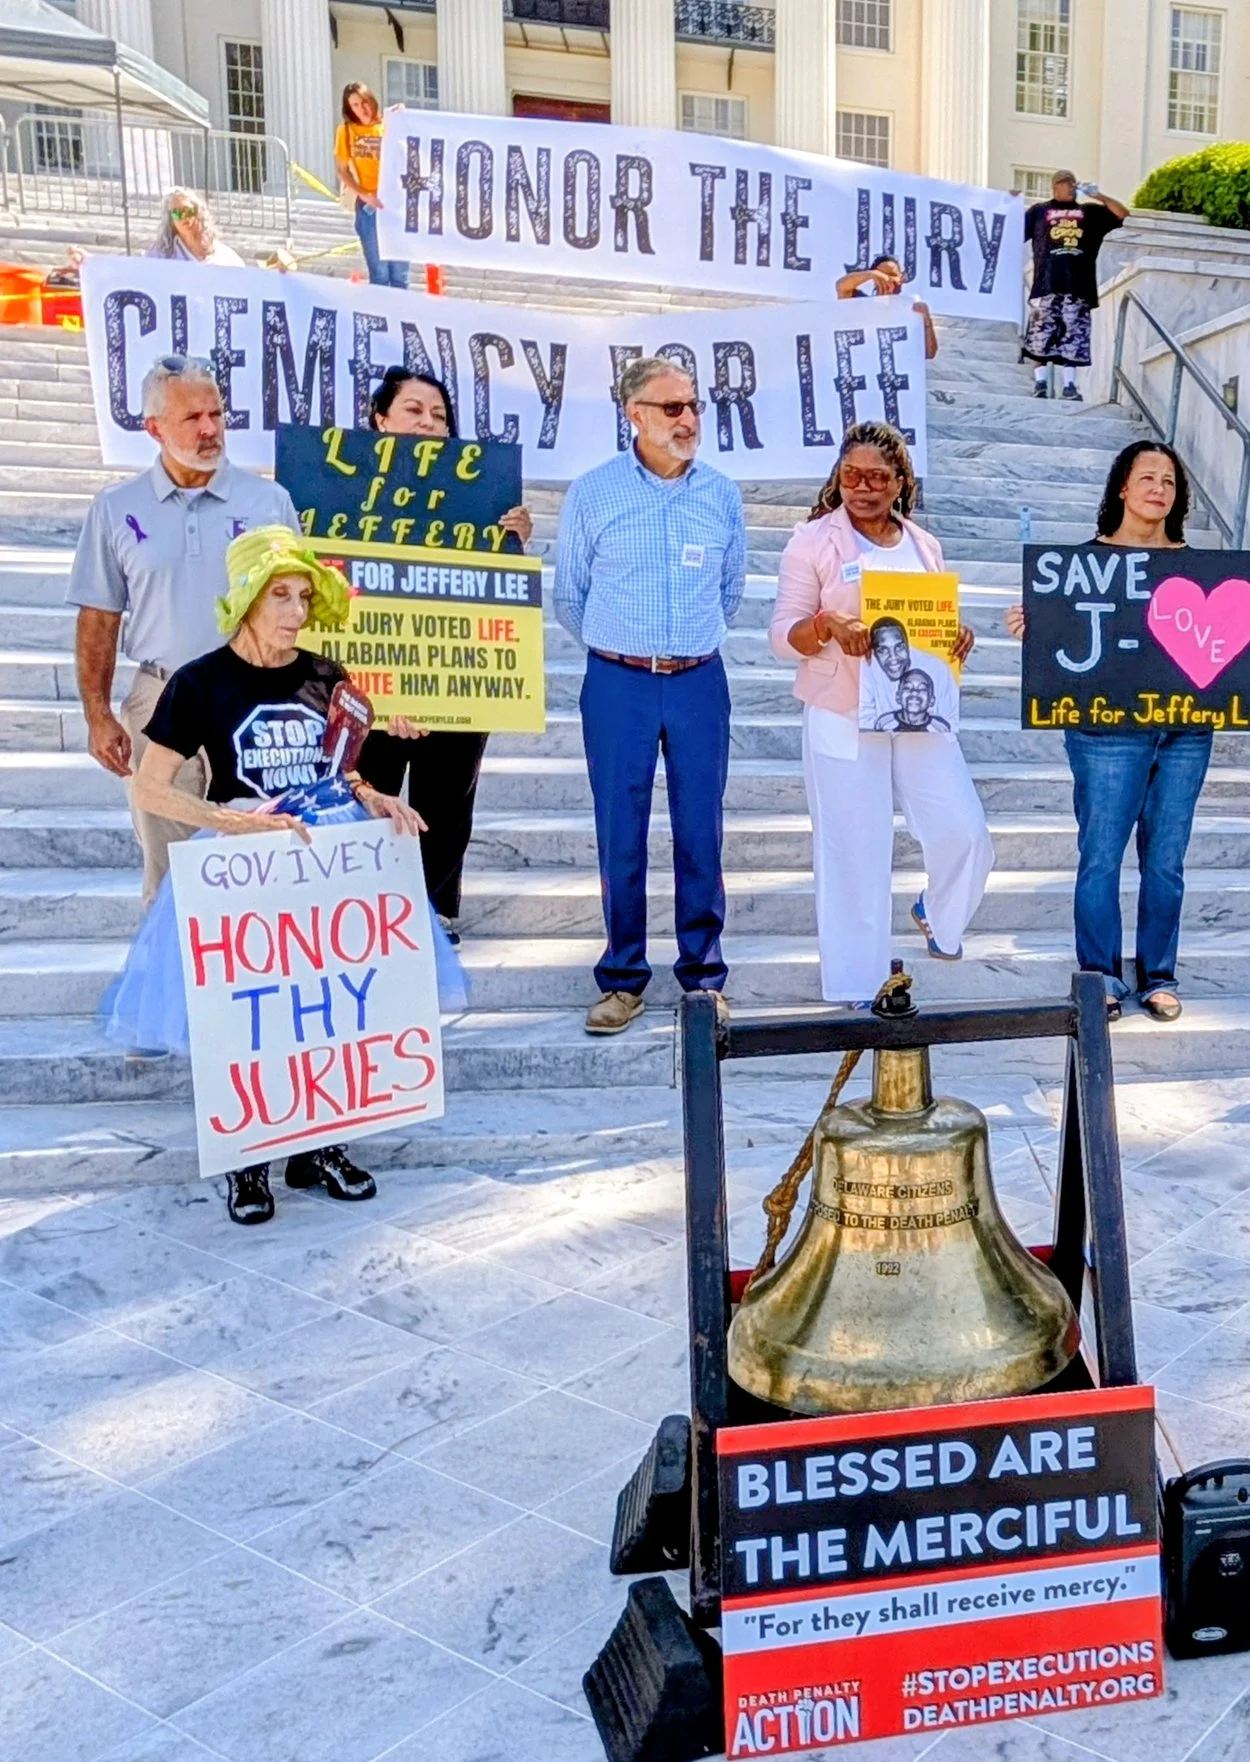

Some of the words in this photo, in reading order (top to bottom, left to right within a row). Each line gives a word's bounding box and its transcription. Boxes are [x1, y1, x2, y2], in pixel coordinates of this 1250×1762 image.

[401, 136, 655, 255] HONOR
[689, 162, 812, 272] THE
[796, 326, 916, 448] LEE
[321, 426, 482, 481] LIFE
[360, 476, 446, 512] for
[351, 561, 394, 591] FOR
[401, 564, 488, 598] JEFFERY
[494, 573, 529, 600] LEE
[1032, 552, 1152, 600] SAVE
[352, 610, 405, 637] JURY
[411, 614, 471, 640] VOTED
[478, 619, 520, 643] LIFE.
[865, 598, 881, 611] THE
[884, 599, 905, 612] JURY
[907, 599, 933, 612] VOTED
[1150, 595, 1227, 664] LOVE
[321, 640, 420, 667] ALABAMA
[428, 645, 488, 669] PLANS
[494, 648, 517, 670] TO
[400, 674, 439, 697] HIM
[447, 675, 531, 700] ANYWAY.
[1031, 697, 1081, 725] Life
[1090, 697, 1125, 724] for
[1134, 693, 1226, 729] Jeffery
[251, 719, 324, 747] STOP
[201, 851, 279, 890] GOV.
[287, 836, 400, 883] IVEY:
[188, 894, 420, 986] HONOR
[232, 967, 378, 1051] THY
[210, 1028, 437, 1134] JURIES
[832, 1179, 894, 1198] DELAWARE
[897, 1181, 953, 1199] CITIZENS
[844, 1213, 858, 1227] TO
[861, 1215, 886, 1229] THE
[890, 1215, 933, 1229] DEATH
[876, 1261, 900, 1276] 1992
[737, 1441, 976, 1509] BLESSED
[988, 1426, 1096, 1478] ARE
[735, 1527, 849, 1583] THE
[863, 1493, 1141, 1568] MERCIFUL
[744, 1612, 803, 1639] "For
[811, 1605, 871, 1636] they
[879, 1592, 938, 1622] shall
[947, 1583, 1036, 1613] receive
[1043, 1565, 1136, 1602] mercy."
[738, 1690, 787, 1708] DEATH
[793, 1681, 860, 1703] PENALTY
[902, 1641, 1155, 1697] #STOPEXECUTIONS
[731, 1697, 860, 1756] ACTION
[903, 1673, 1154, 1730] DEATHPENALTY.ORG
